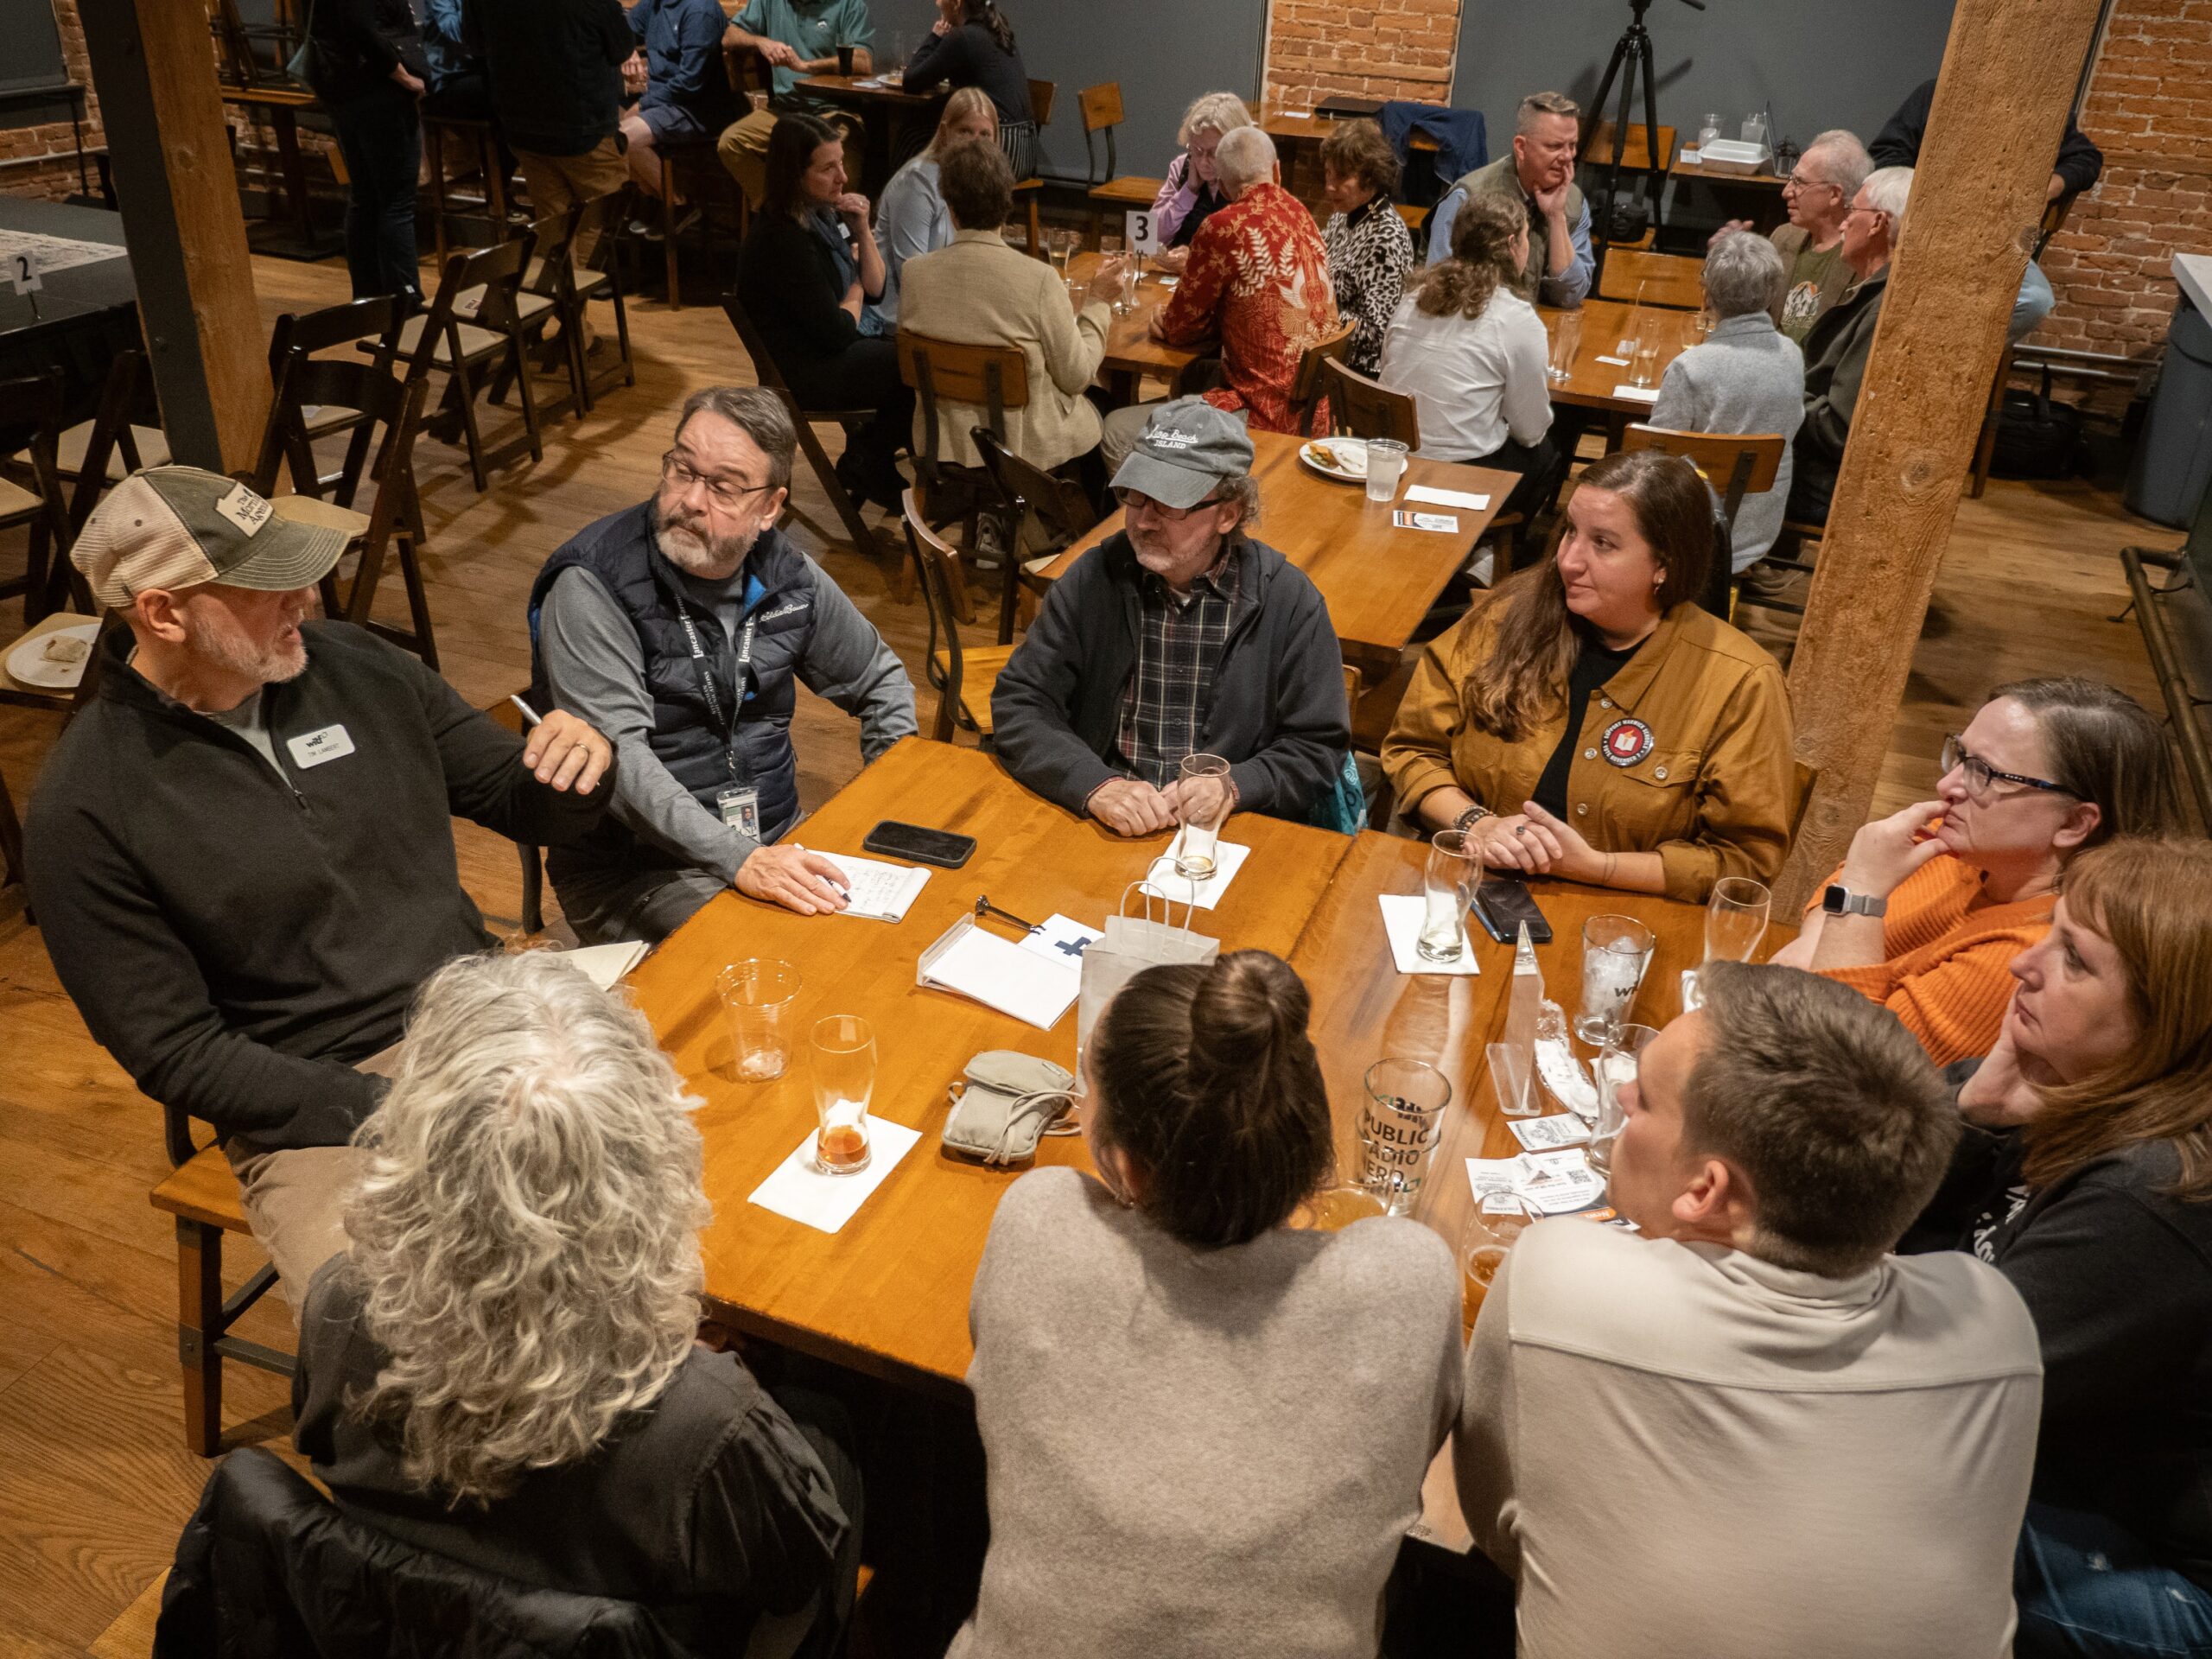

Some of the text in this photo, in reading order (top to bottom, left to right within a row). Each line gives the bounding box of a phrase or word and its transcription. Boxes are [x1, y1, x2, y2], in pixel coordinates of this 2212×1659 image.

[1135, 215, 1149, 242] 3
[16, 256, 33, 283] 2
[1154, 440, 1186, 449] ISLAND
[683, 620, 704, 658] Lancaster
[738, 626, 753, 663] Lancaster
[1364, 1108, 1430, 1146] PUBLIC
